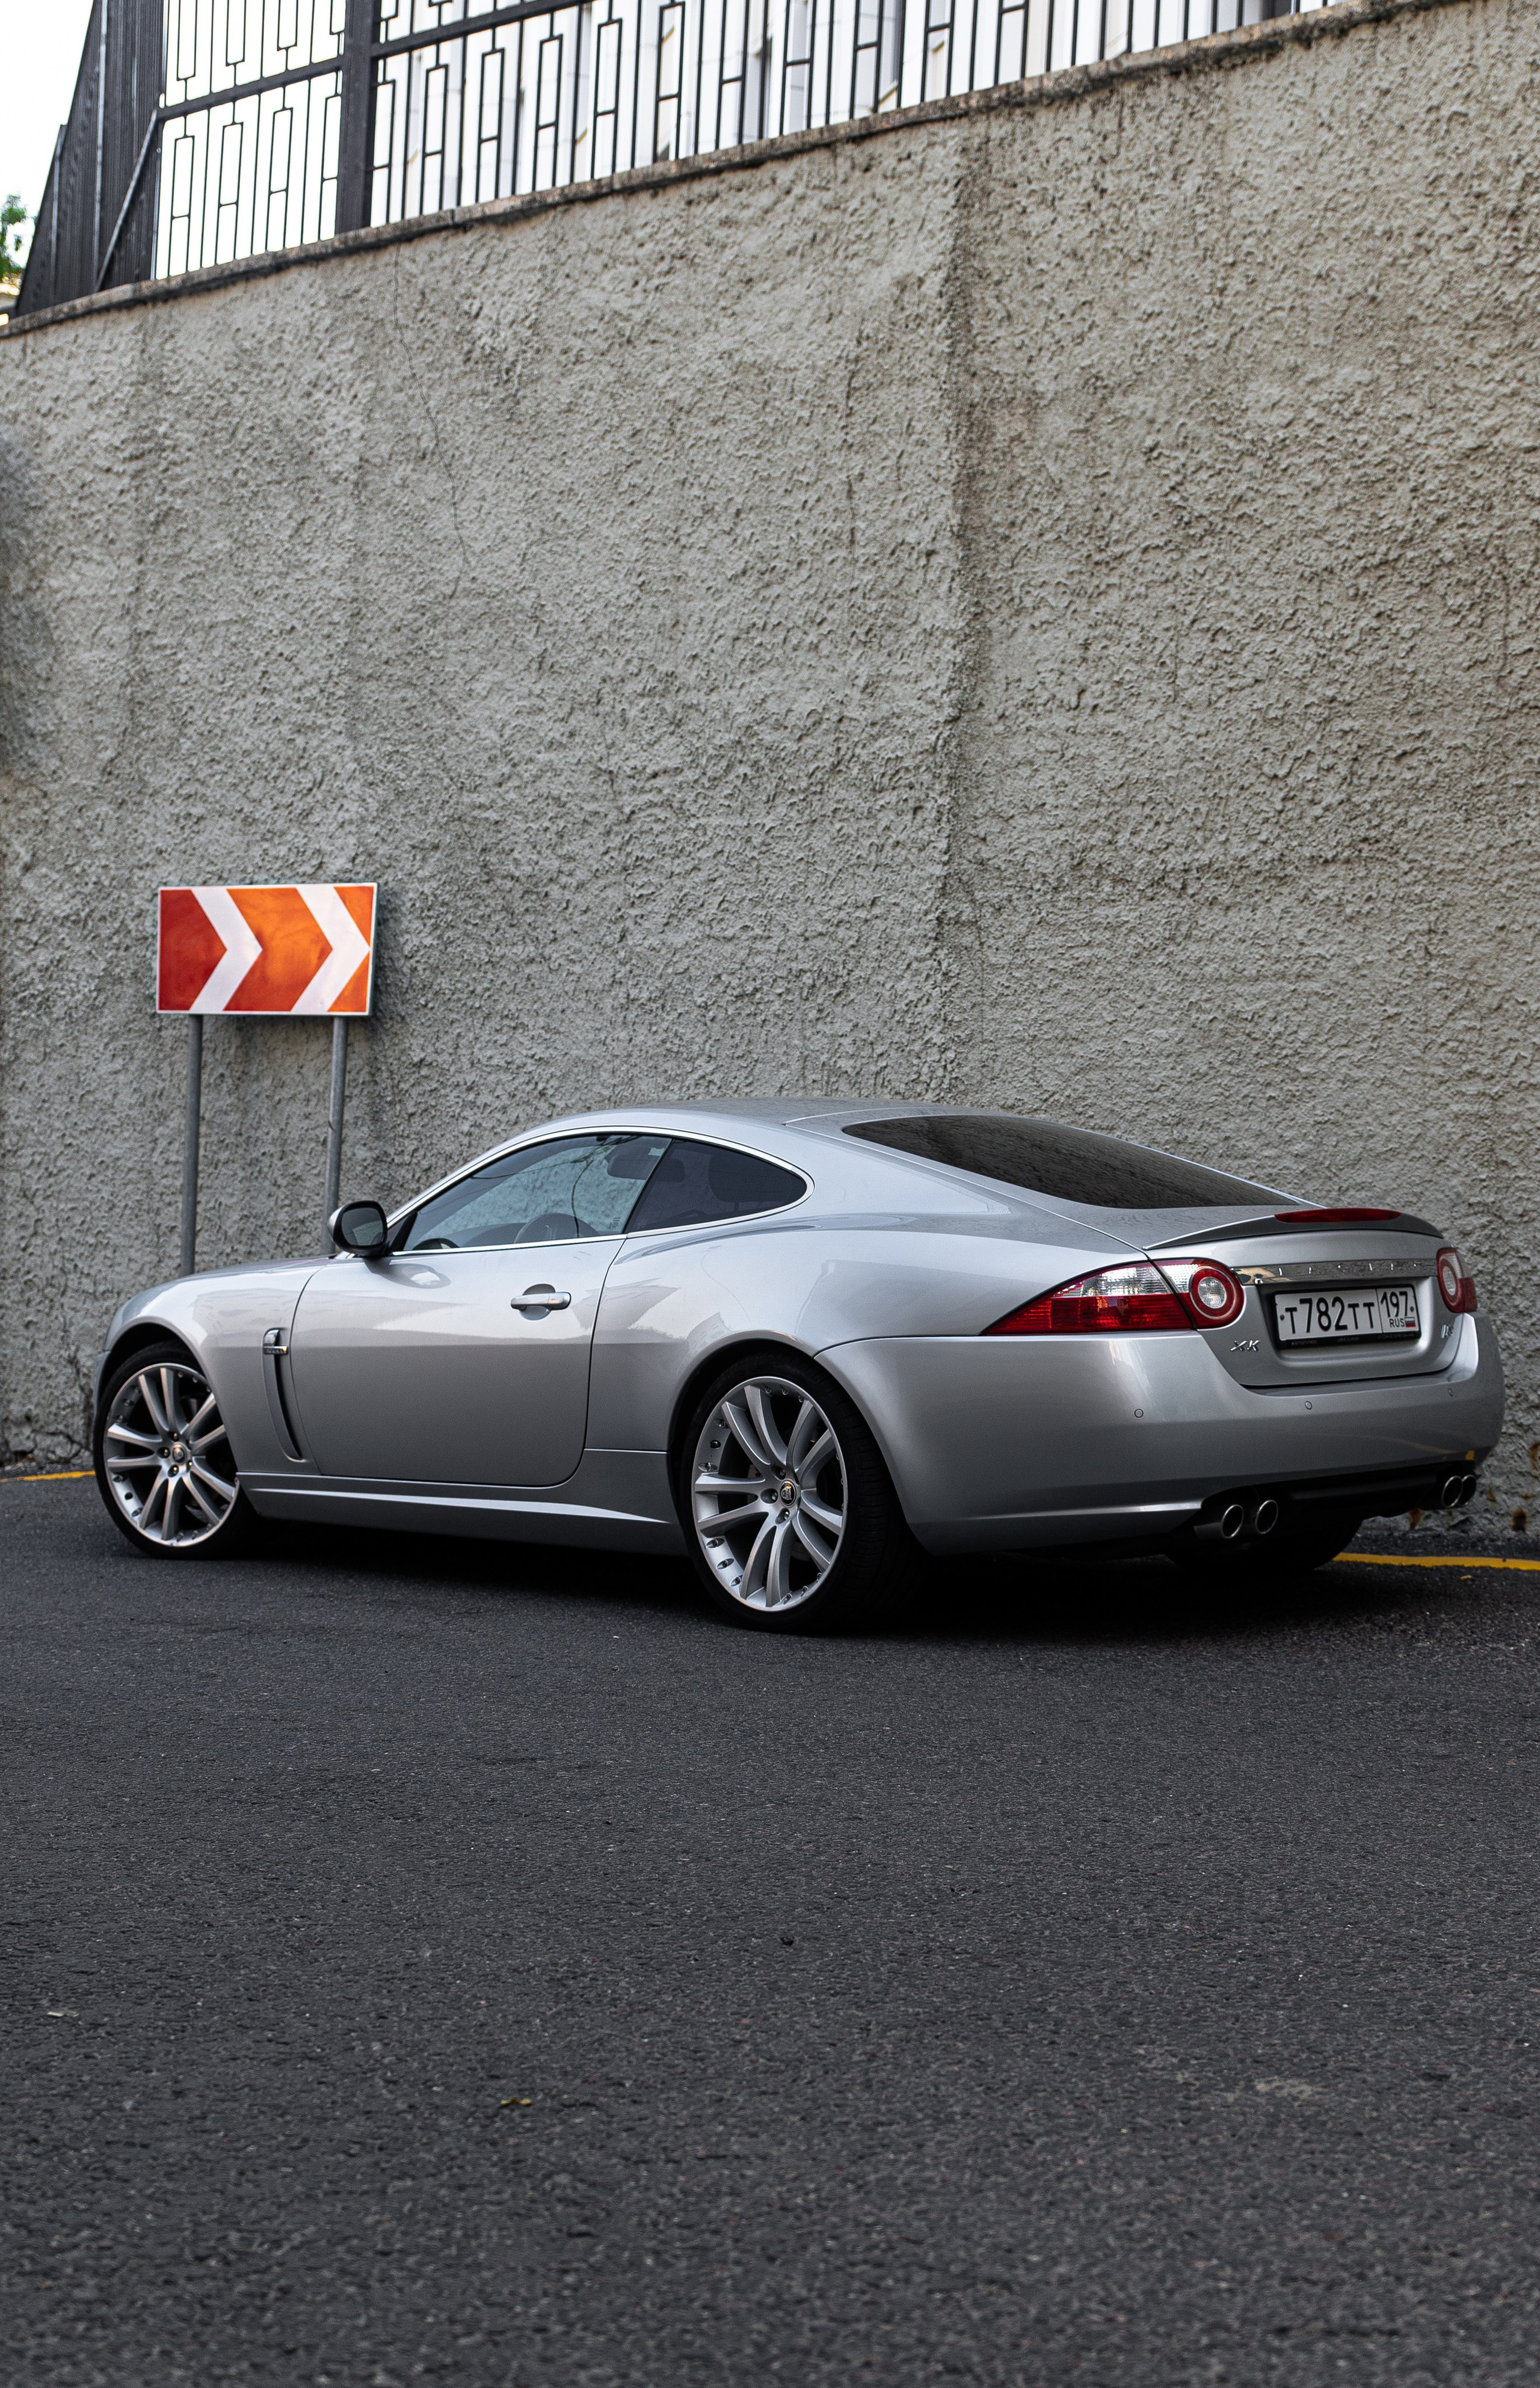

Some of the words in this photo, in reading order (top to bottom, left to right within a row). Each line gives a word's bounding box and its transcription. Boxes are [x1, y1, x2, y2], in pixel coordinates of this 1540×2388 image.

[1380, 1291, 1408, 1318] 197
[1389, 1317, 1405, 1328] RUS
[1230, 1340, 1260, 1352] XK
